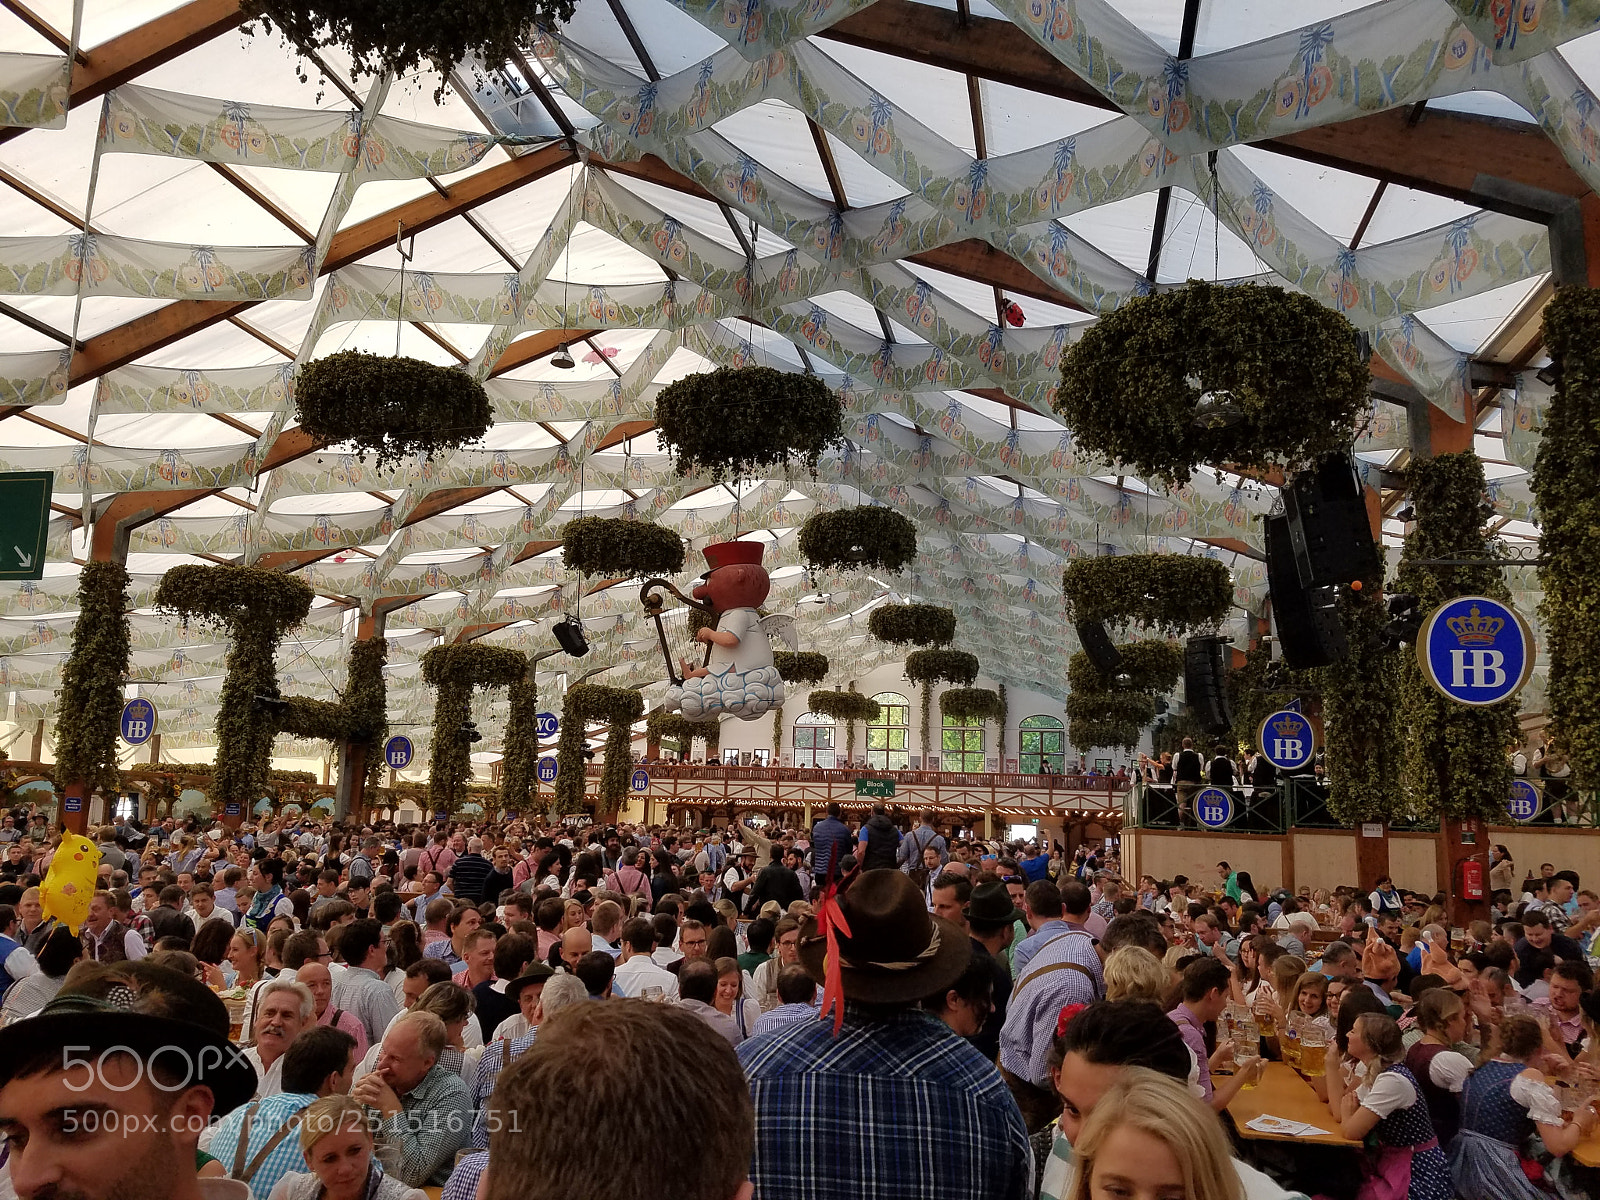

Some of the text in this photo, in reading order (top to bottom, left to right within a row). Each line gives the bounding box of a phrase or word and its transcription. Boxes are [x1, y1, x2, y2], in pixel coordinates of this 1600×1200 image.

[1449, 649, 1507, 688] HB
[126, 720, 148, 738] HB
[1273, 738, 1304, 760] HB
[390, 751, 408, 765] HB
[540, 768, 554, 779] HB
[634, 780, 645, 789] HB
[1203, 806, 1225, 822] HB
[1509, 799, 1532, 815] HB
